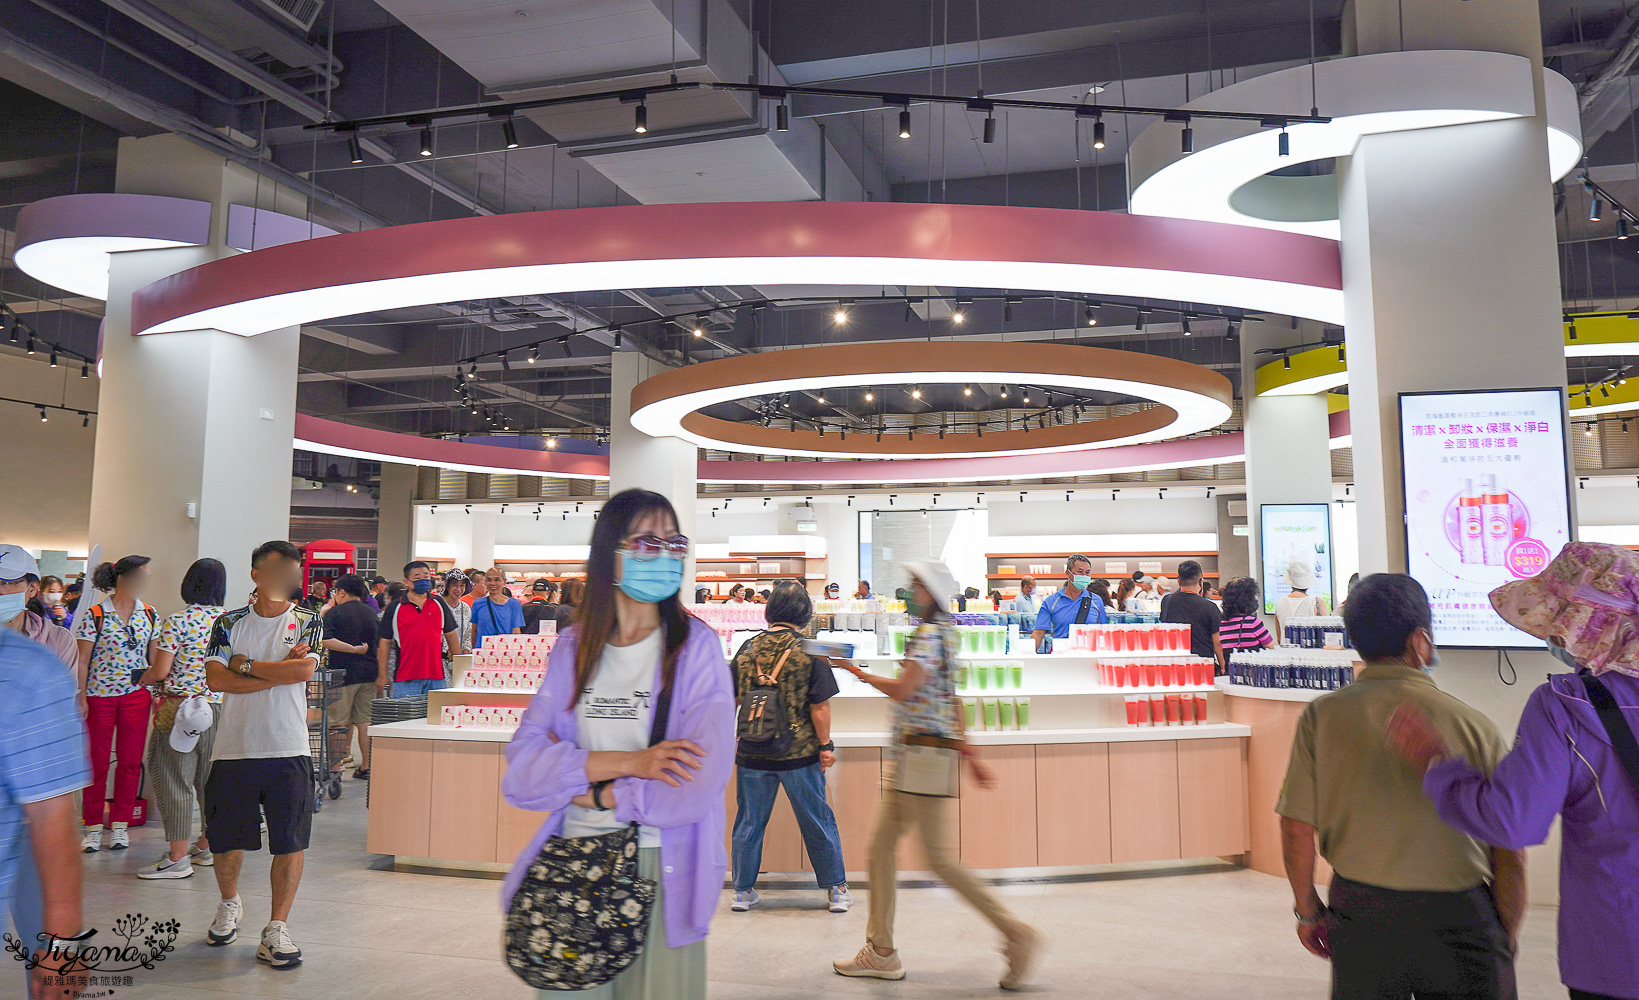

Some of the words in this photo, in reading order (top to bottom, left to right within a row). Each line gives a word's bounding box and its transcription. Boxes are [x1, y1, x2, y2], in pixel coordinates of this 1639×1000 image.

[1412, 425, 1436, 436] 清潔
[1449, 424, 1473, 435] 卸妝
[1486, 422, 1511, 434] 保濕
[1524, 421, 1549, 433] 淨白
[1444, 437, 1518, 449] 全面獲得滋養
[1514, 556, 1543, 566] $319
